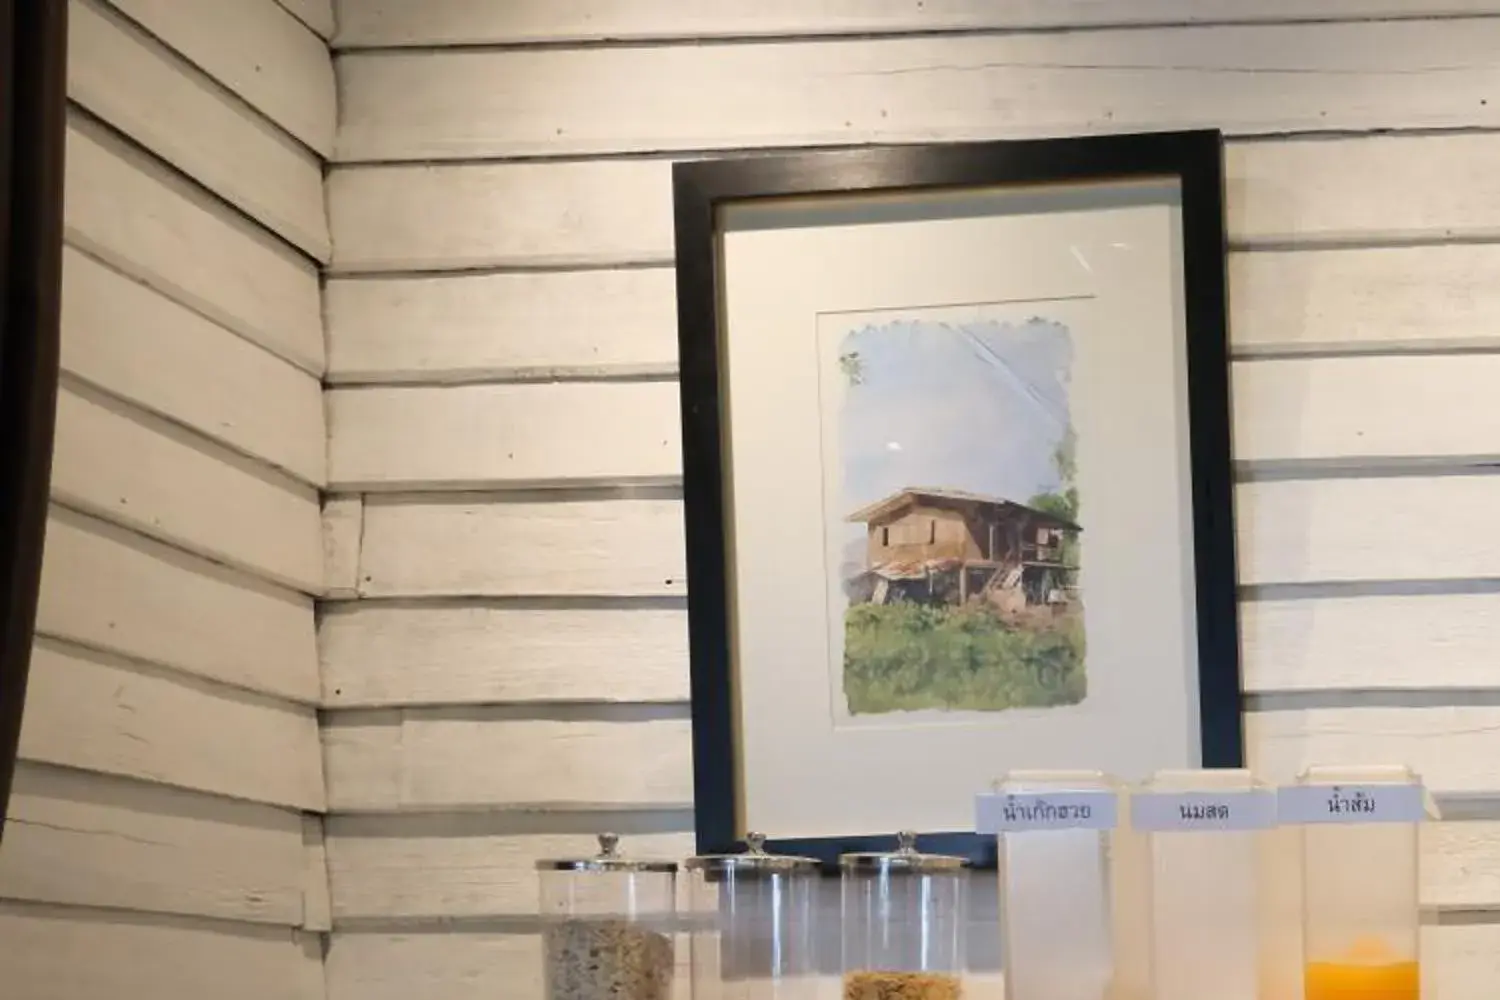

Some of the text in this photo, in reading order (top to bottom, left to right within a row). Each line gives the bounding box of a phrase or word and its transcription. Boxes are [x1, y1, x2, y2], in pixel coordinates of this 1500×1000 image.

[1327, 786, 1376, 813] น้ำส้ม
[1179, 804, 1229, 819] นมสด
